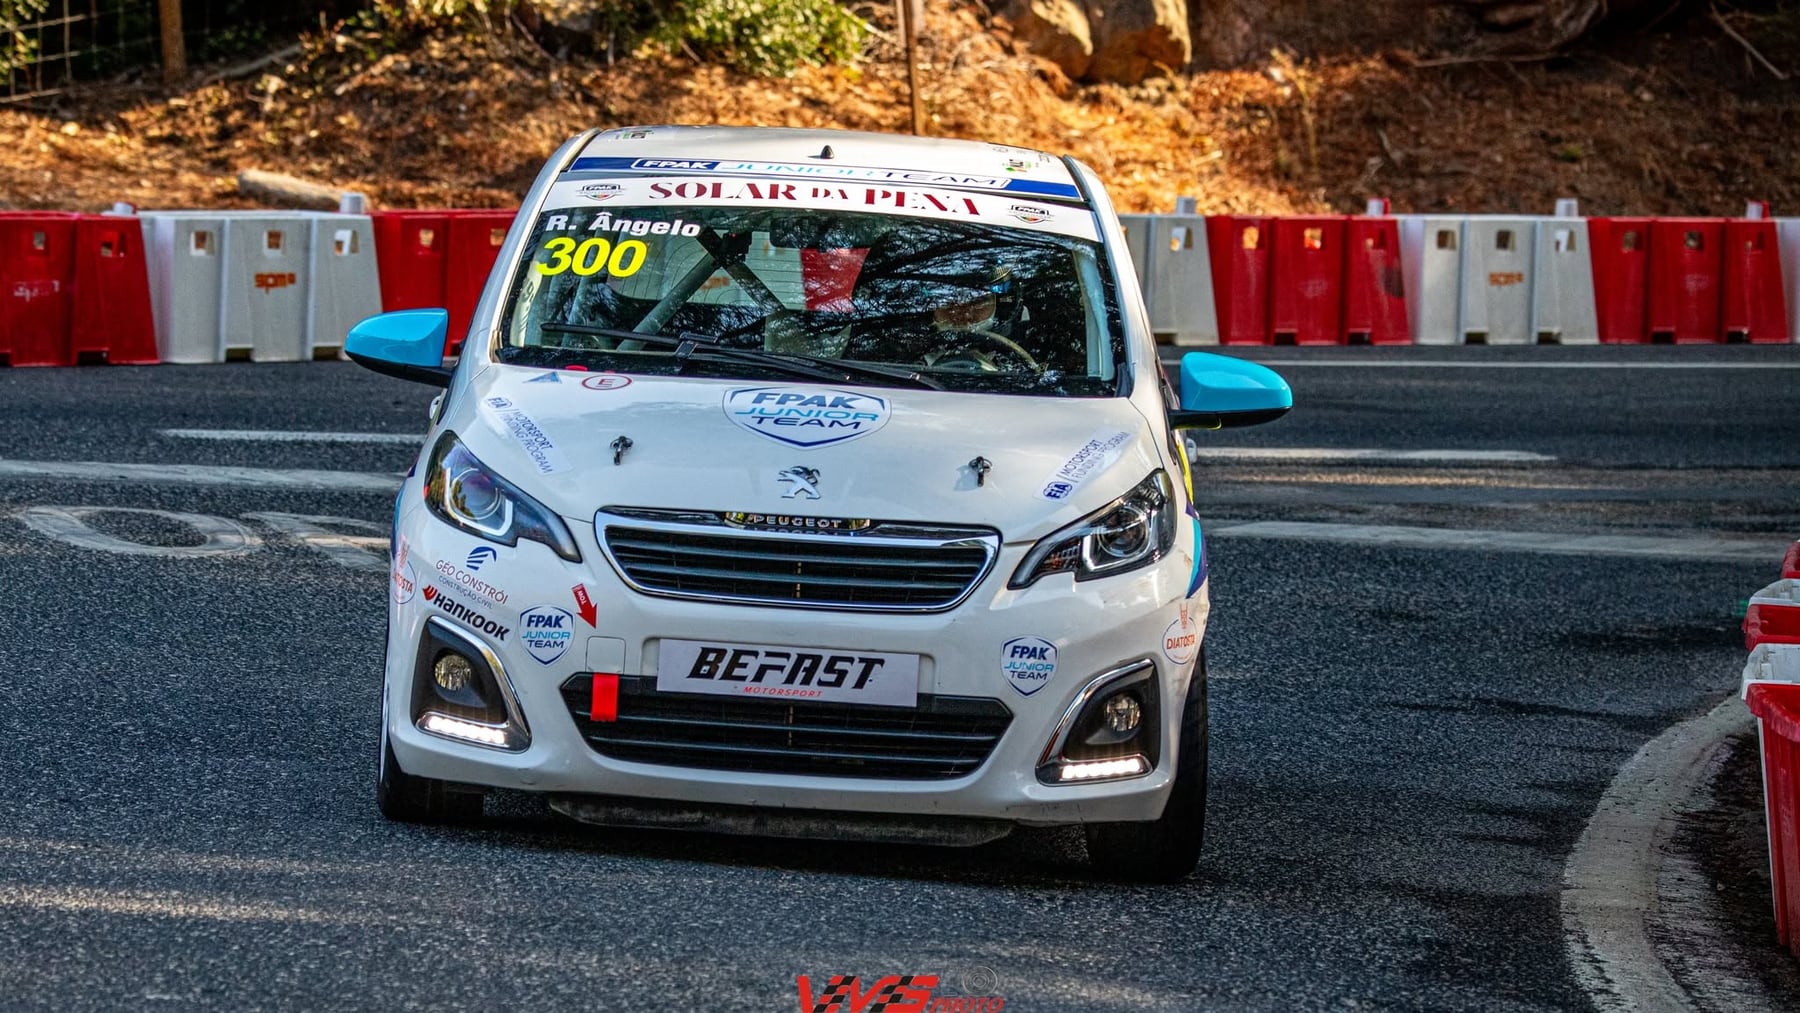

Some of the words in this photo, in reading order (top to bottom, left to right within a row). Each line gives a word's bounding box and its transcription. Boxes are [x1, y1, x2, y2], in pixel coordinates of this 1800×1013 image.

[642, 160, 715, 169] FPAK
[877, 171, 996, 185] TEAM
[649, 182, 798, 200] SOLAR
[811, 187, 849, 200] DA
[864, 188, 981, 216] PENA
[545, 214, 577, 232] R.
[588, 211, 701, 237] Ângelo
[536, 236, 648, 278] 300
[751, 392, 862, 410] FPAK
[734, 406, 880, 422] JUNIOR
[512, 410, 554, 450] MOTORSPORT
[751, 415, 862, 430] TEAM
[521, 438, 554, 474] PROGRAM
[1060, 439, 1103, 477] MOTORSPORT
[1046, 483, 1070, 499] FIA
[753, 513, 842, 529] PEUGEOT
[455, 569, 509, 605] CONSTRÓI
[476, 596, 493, 610] CIVIL
[526, 614, 566, 629] FPAK
[521, 631, 571, 641] JUNIOR
[527, 639, 565, 649] TEAM
[1009, 645, 1050, 662] FPAK
[686, 647, 886, 690] BEFAST
[1003, 661, 1055, 673] JUNIOR
[1009, 670, 1048, 681] TEAM
[742, 685, 823, 698] MOTORSPORT
